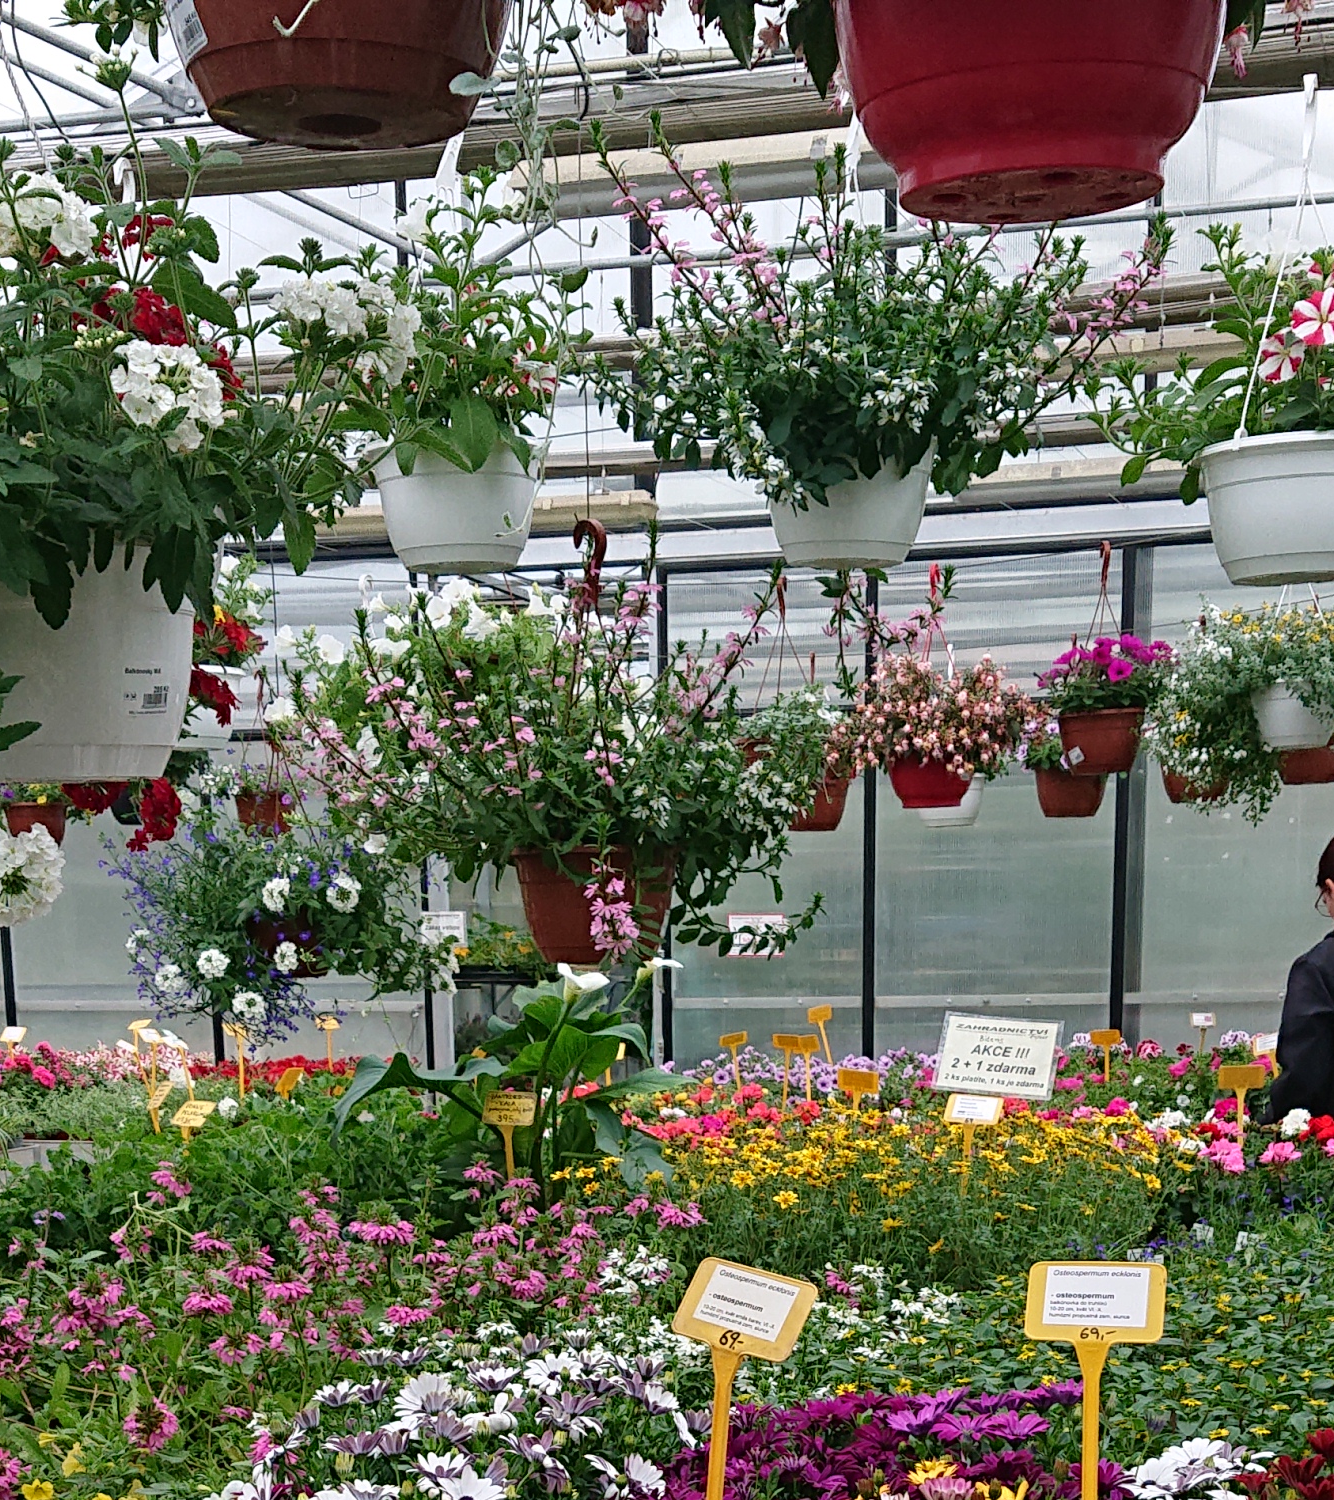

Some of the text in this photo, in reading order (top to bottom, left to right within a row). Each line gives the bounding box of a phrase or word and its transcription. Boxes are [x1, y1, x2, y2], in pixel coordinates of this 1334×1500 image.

[971, 1045, 1030, 1059] AKCE !!!
[951, 1058, 960, 1068] 2
[976, 1061, 983, 1071] 1
[986, 1062, 1036, 1076] zdarma
[951, 1073, 960, 1081] ks
[996, 1078, 1005, 1086] ks
[1006, 1079, 1014, 1088] je
[1015, 1080, 1044, 1089] zdarma
[719, 1269, 768, 1289] Osteospermum
[1053, 1269, 1142, 1278] Osteospermum ecklonis
[712, 1292, 763, 1313] osteospermum
[1056, 1292, 1115, 1300] osteospermum
